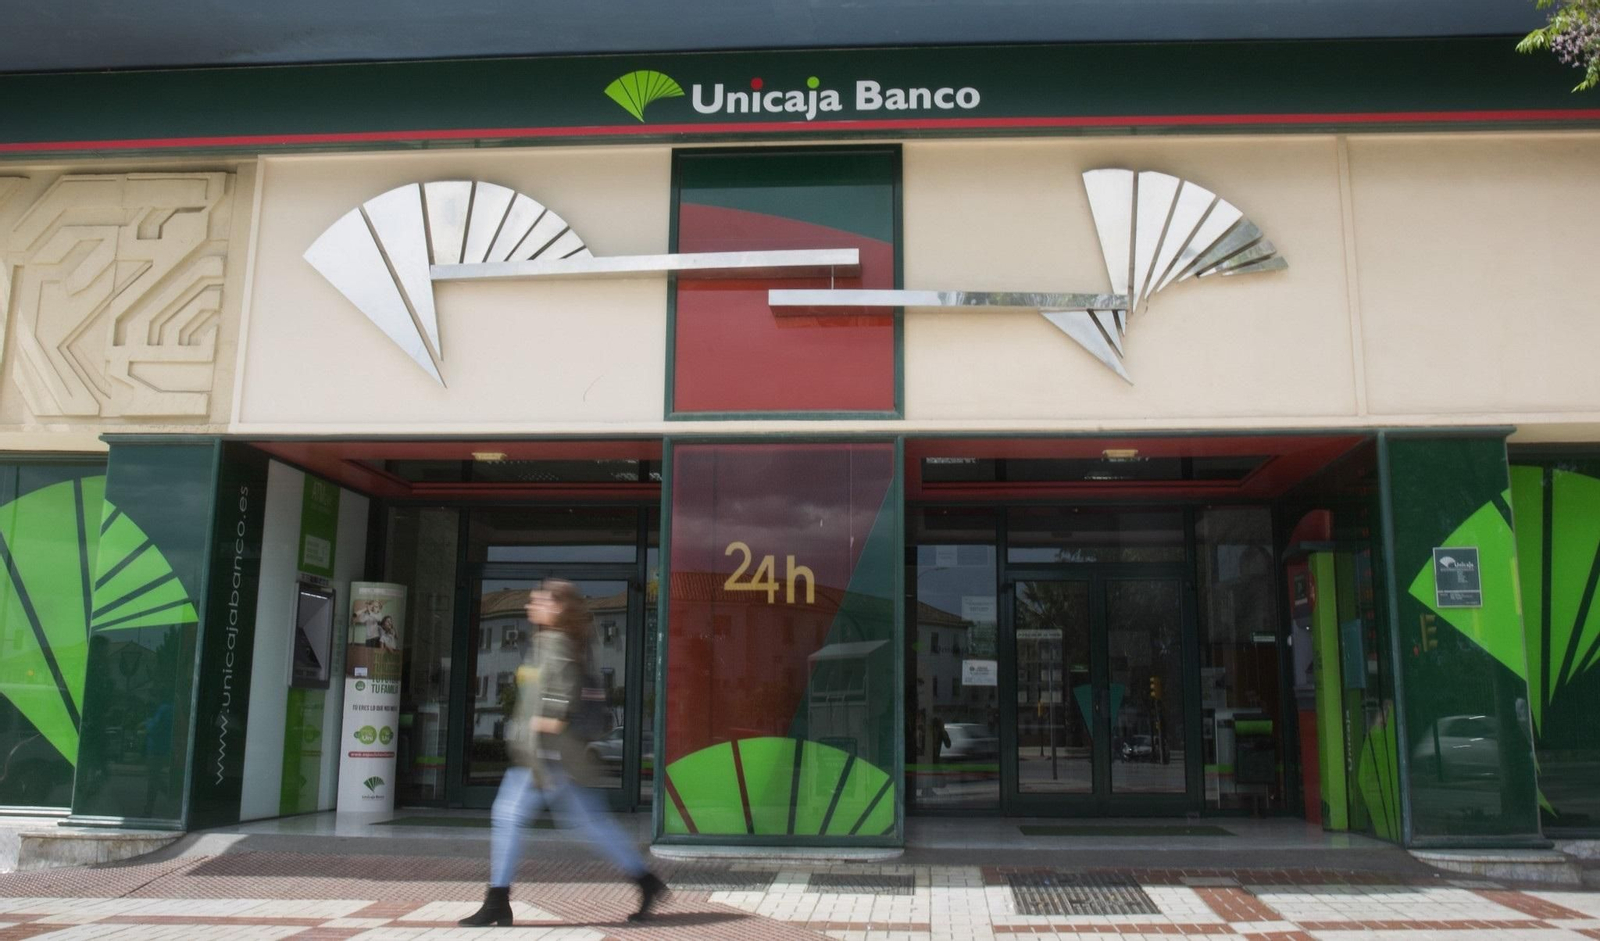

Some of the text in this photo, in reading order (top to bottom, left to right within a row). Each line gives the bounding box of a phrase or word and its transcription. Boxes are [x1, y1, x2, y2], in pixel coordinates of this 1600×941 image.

[691, 76, 981, 121] Unicaja Banco
[723, 541, 815, 604] 24h
[215, 485, 249, 786] www.unicajabanco.es
